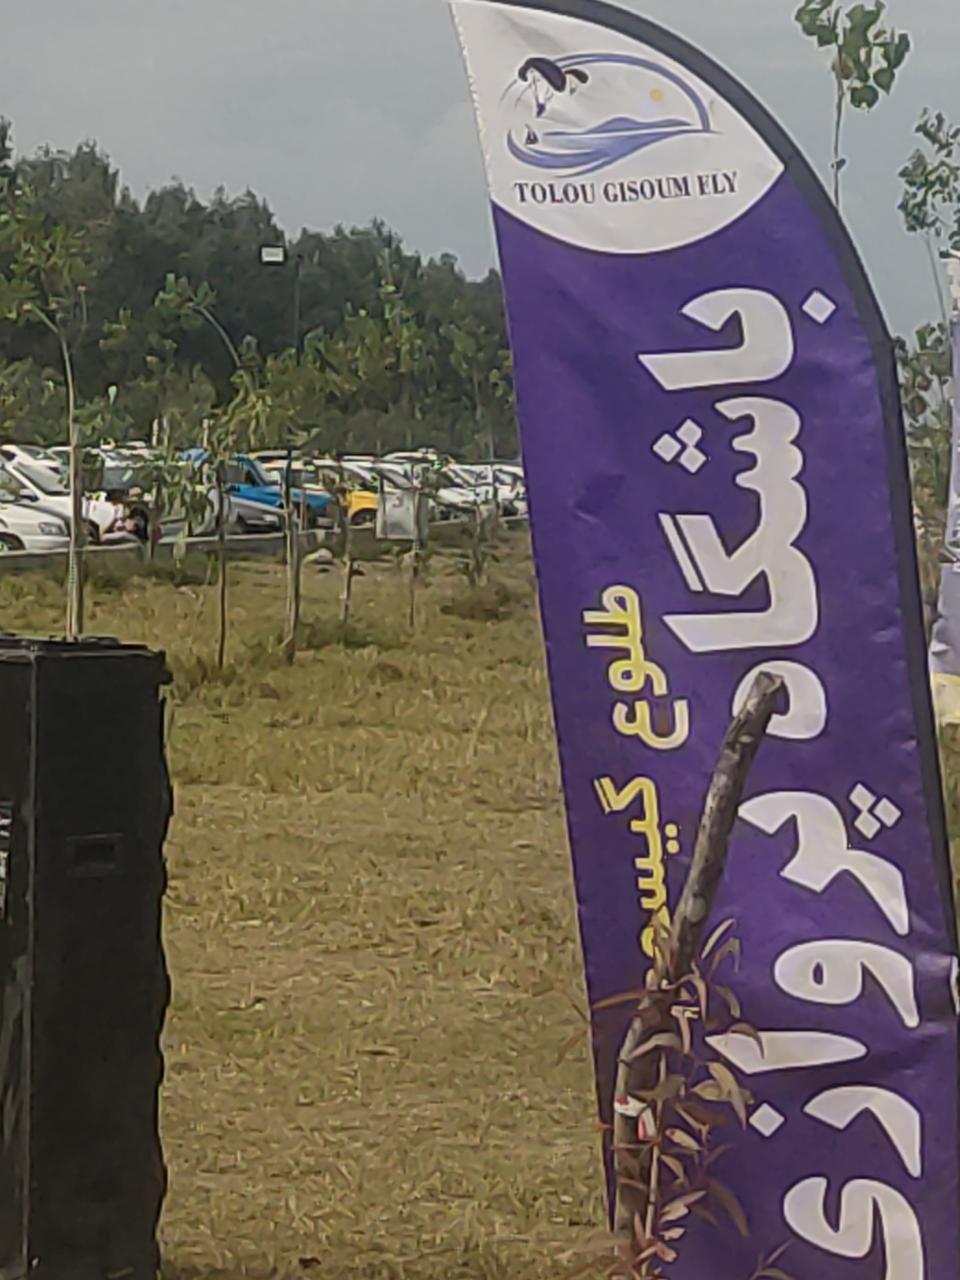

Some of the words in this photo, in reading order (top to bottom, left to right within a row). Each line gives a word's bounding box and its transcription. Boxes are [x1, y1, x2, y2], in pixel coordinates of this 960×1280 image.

[514, 182, 595, 204] TOLOU
[602, 176, 691, 202] GISOUM
[637, 287, 837, 740] باشگاه
[583, 584, 690, 750] طلوع
